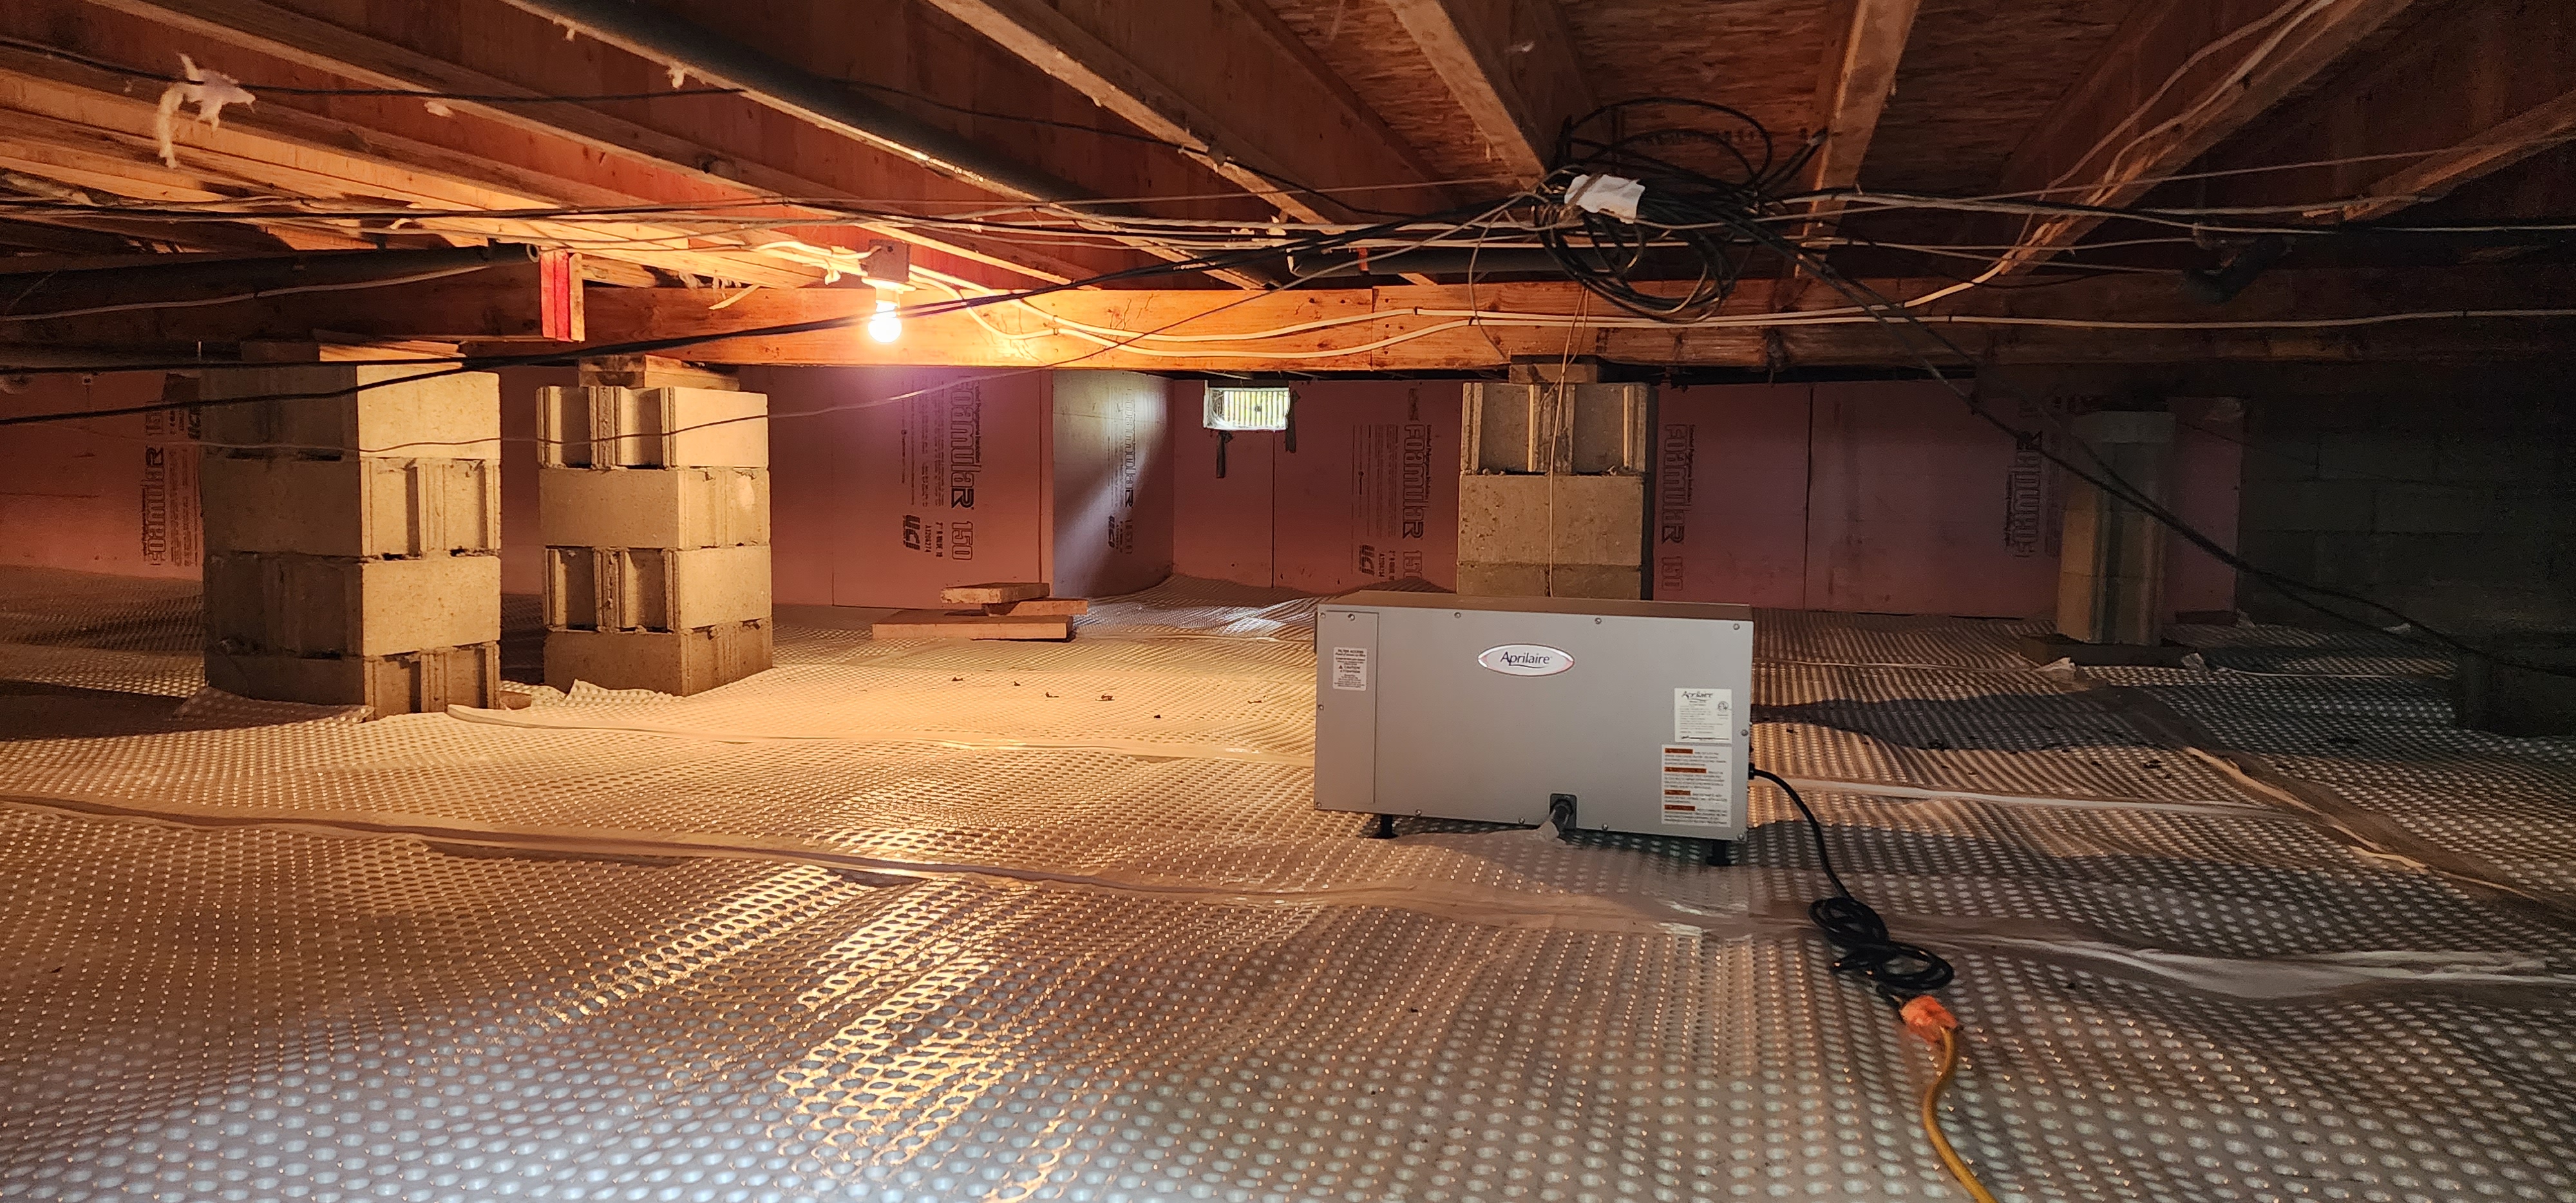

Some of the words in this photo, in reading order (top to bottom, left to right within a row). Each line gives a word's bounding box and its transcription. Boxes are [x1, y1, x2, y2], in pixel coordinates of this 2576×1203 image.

[906, 515, 921, 550] UCI
[952, 521, 973, 560] 150
[1362, 545, 1374, 576] UCI
[1662, 556, 1683, 591] 150
[1500, 651, 1550, 666] Aprilaire
